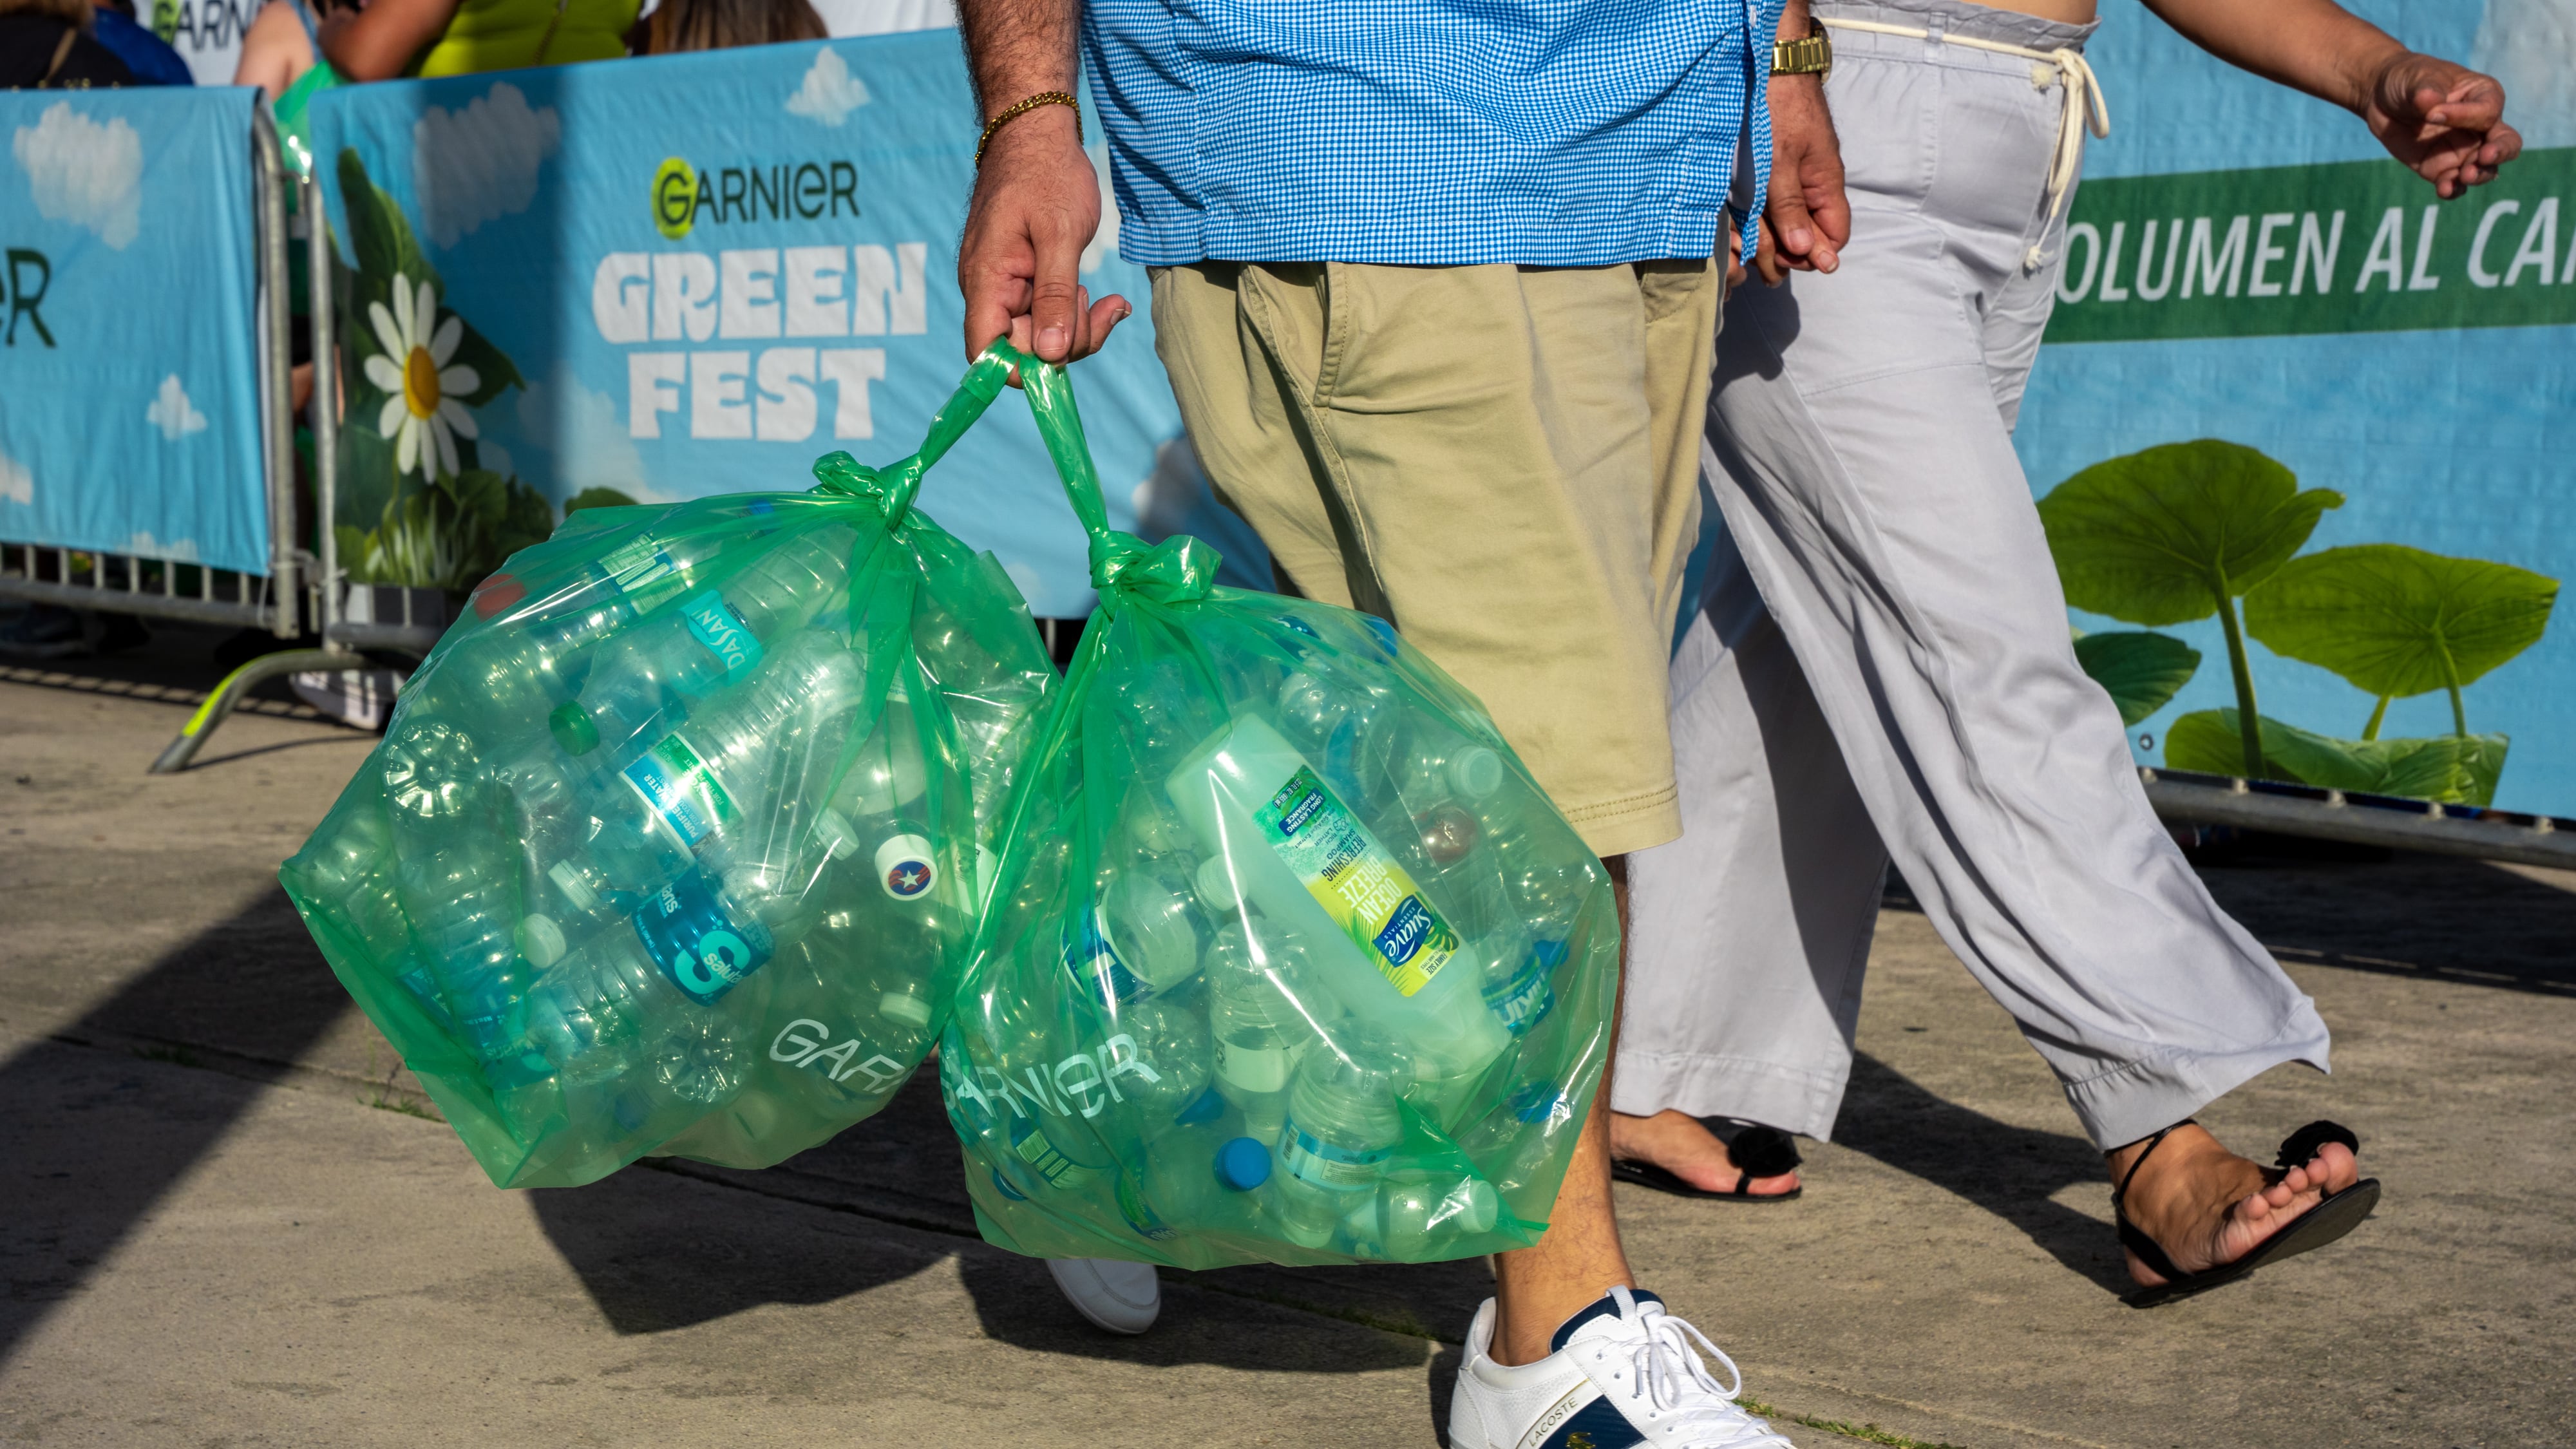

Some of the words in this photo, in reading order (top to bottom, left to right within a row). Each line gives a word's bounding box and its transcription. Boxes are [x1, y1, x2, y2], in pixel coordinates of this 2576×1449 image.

[658, 160, 861, 225] GARNIER
[2055, 209, 2345, 304] OLUMEN
[2354, 204, 2439, 294] AL
[0, 247, 57, 350] R
[591, 242, 928, 345] GREEN
[627, 347, 887, 442] FEST
[683, 757, 705, 782] PLNET
[643, 772, 671, 803] WATER
[1309, 794, 1324, 810] LONG
[1284, 791, 1317, 825] FRAGRANCE
[1285, 806, 1312, 833] LASTING
[1294, 831, 1311, 849] Extract
[1313, 827, 1333, 847] LATHER
[1324, 831, 1338, 845] RICH
[1324, 828, 1357, 860] SHAMPOO
[1320, 833, 1367, 883] REFRESHING
[1336, 854, 1388, 909] BREEZE
[1355, 875, 1403, 926] OCEAN
[1381, 905, 1433, 958] Suave
[1382, 905, 1416, 940] ESSENTIALS
[1425, 962, 1437, 976] SIZE
[1432, 951, 1448, 968] FAMILY
[769, 1018, 908, 1095] GAR
[1528, 1396, 1578, 1448] LACOSTE
